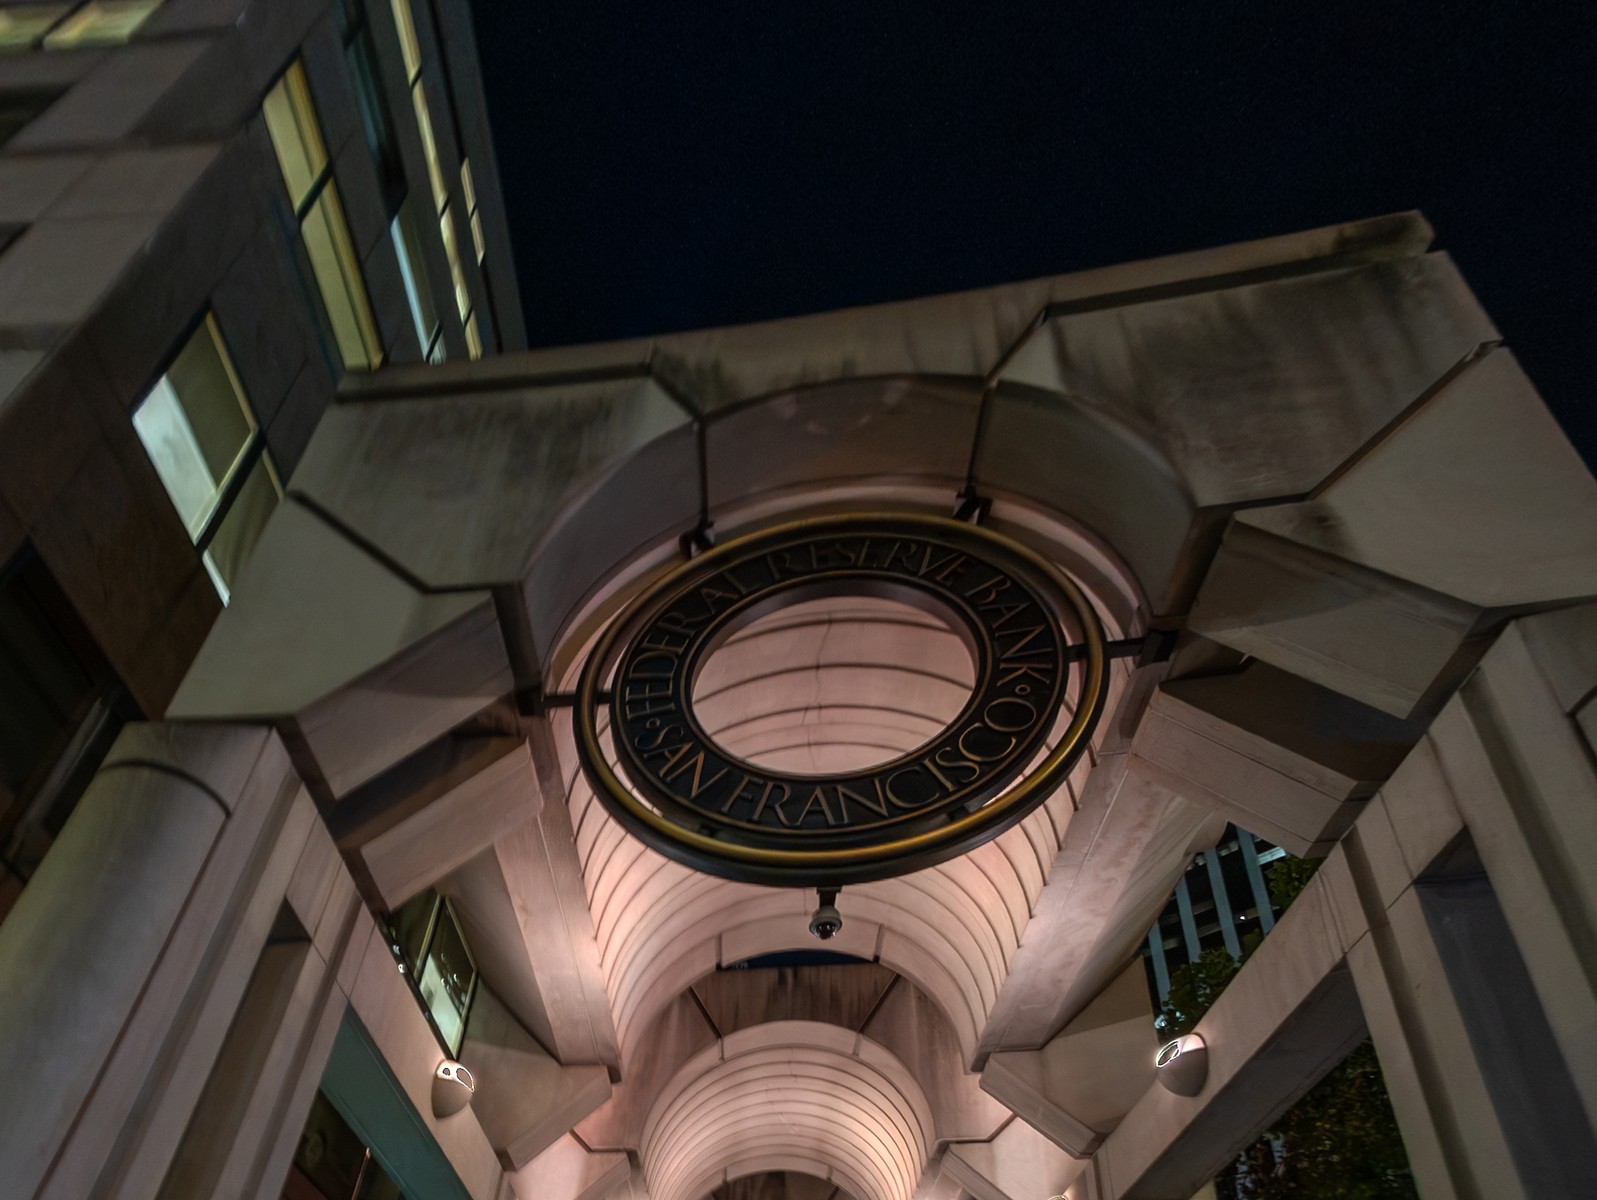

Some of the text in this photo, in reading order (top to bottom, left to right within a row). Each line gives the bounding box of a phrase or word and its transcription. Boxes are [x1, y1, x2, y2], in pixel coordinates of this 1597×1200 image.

[626, 539, 1056, 720] FEDERAL RESERVE BANK
[635, 696, 1037, 826] SAN FRANCISCO
